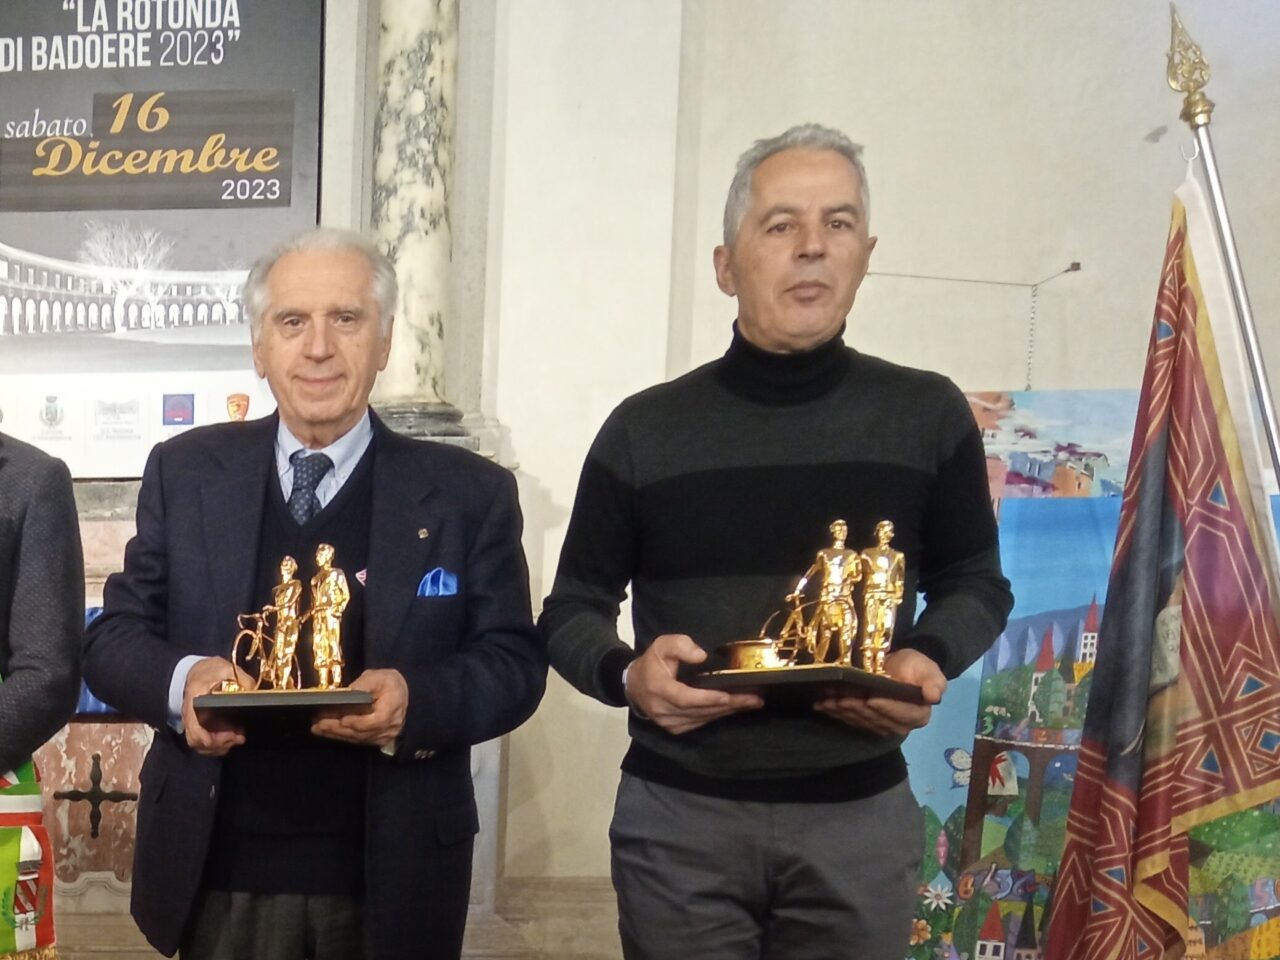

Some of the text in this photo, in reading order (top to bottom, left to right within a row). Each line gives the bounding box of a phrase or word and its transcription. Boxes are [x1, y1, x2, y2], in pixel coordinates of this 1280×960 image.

[117, 0, 240, 31] ROTONDA
[31, 32, 152, 71] BADOERE
[4, 91, 170, 139] sabato 16
[32, 133, 280, 177] Dicembre
[221, 178, 280, 200] 2023
